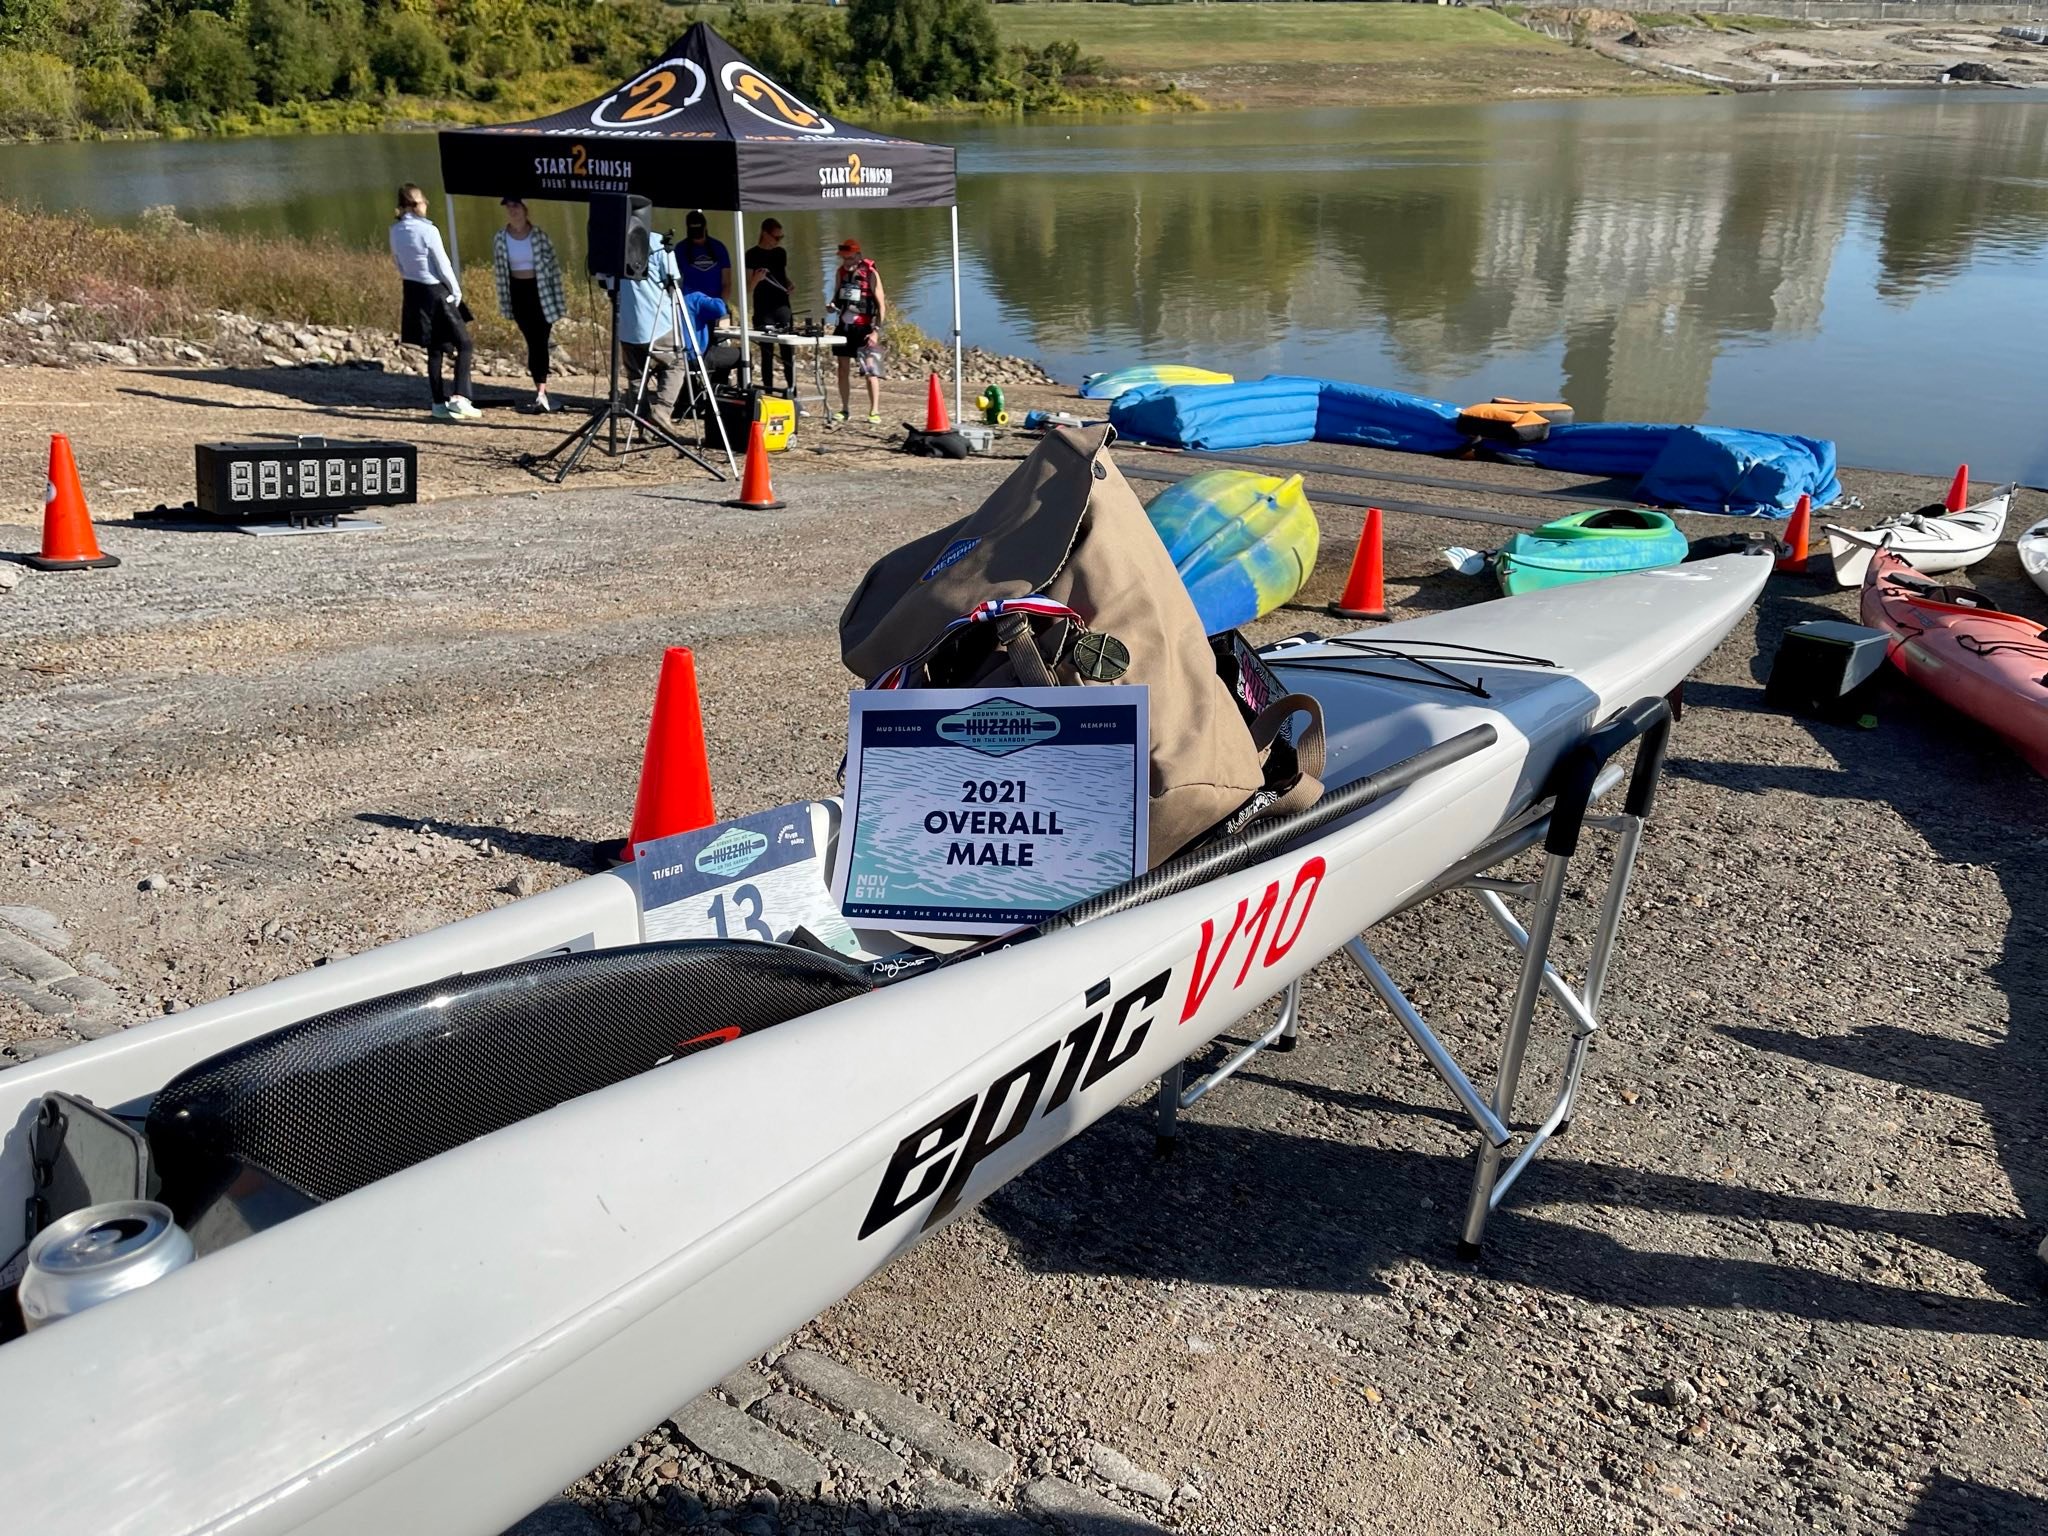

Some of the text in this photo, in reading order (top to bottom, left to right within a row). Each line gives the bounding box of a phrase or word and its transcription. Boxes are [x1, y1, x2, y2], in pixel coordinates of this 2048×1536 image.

[542, 178, 629, 191] EVENT MANAGEMENT
[822, 187, 889, 198] EVENT MANAGEMENT
[876, 725, 922, 733] MUD ISLAND
[966, 718, 1032, 735] HUZZAH
[1080, 721, 1117, 730] MEMPHIS
[961, 780, 1027, 804] 2021
[923, 810, 1064, 836] OVERALL
[785, 832, 799, 840] RIVER
[713, 840, 753, 864] HUZZAH
[946, 843, 1035, 867] MALE
[652, 863, 684, 881] 11/6/21
[857, 874, 889, 888] NOV
[855, 886, 886, 899] 6TH
[706, 883, 774, 942] 13
[852, 908, 890, 916] WINNER
[937, 911, 994, 919] INAUGURAL
[1179, 856, 1327, 1026] V10
